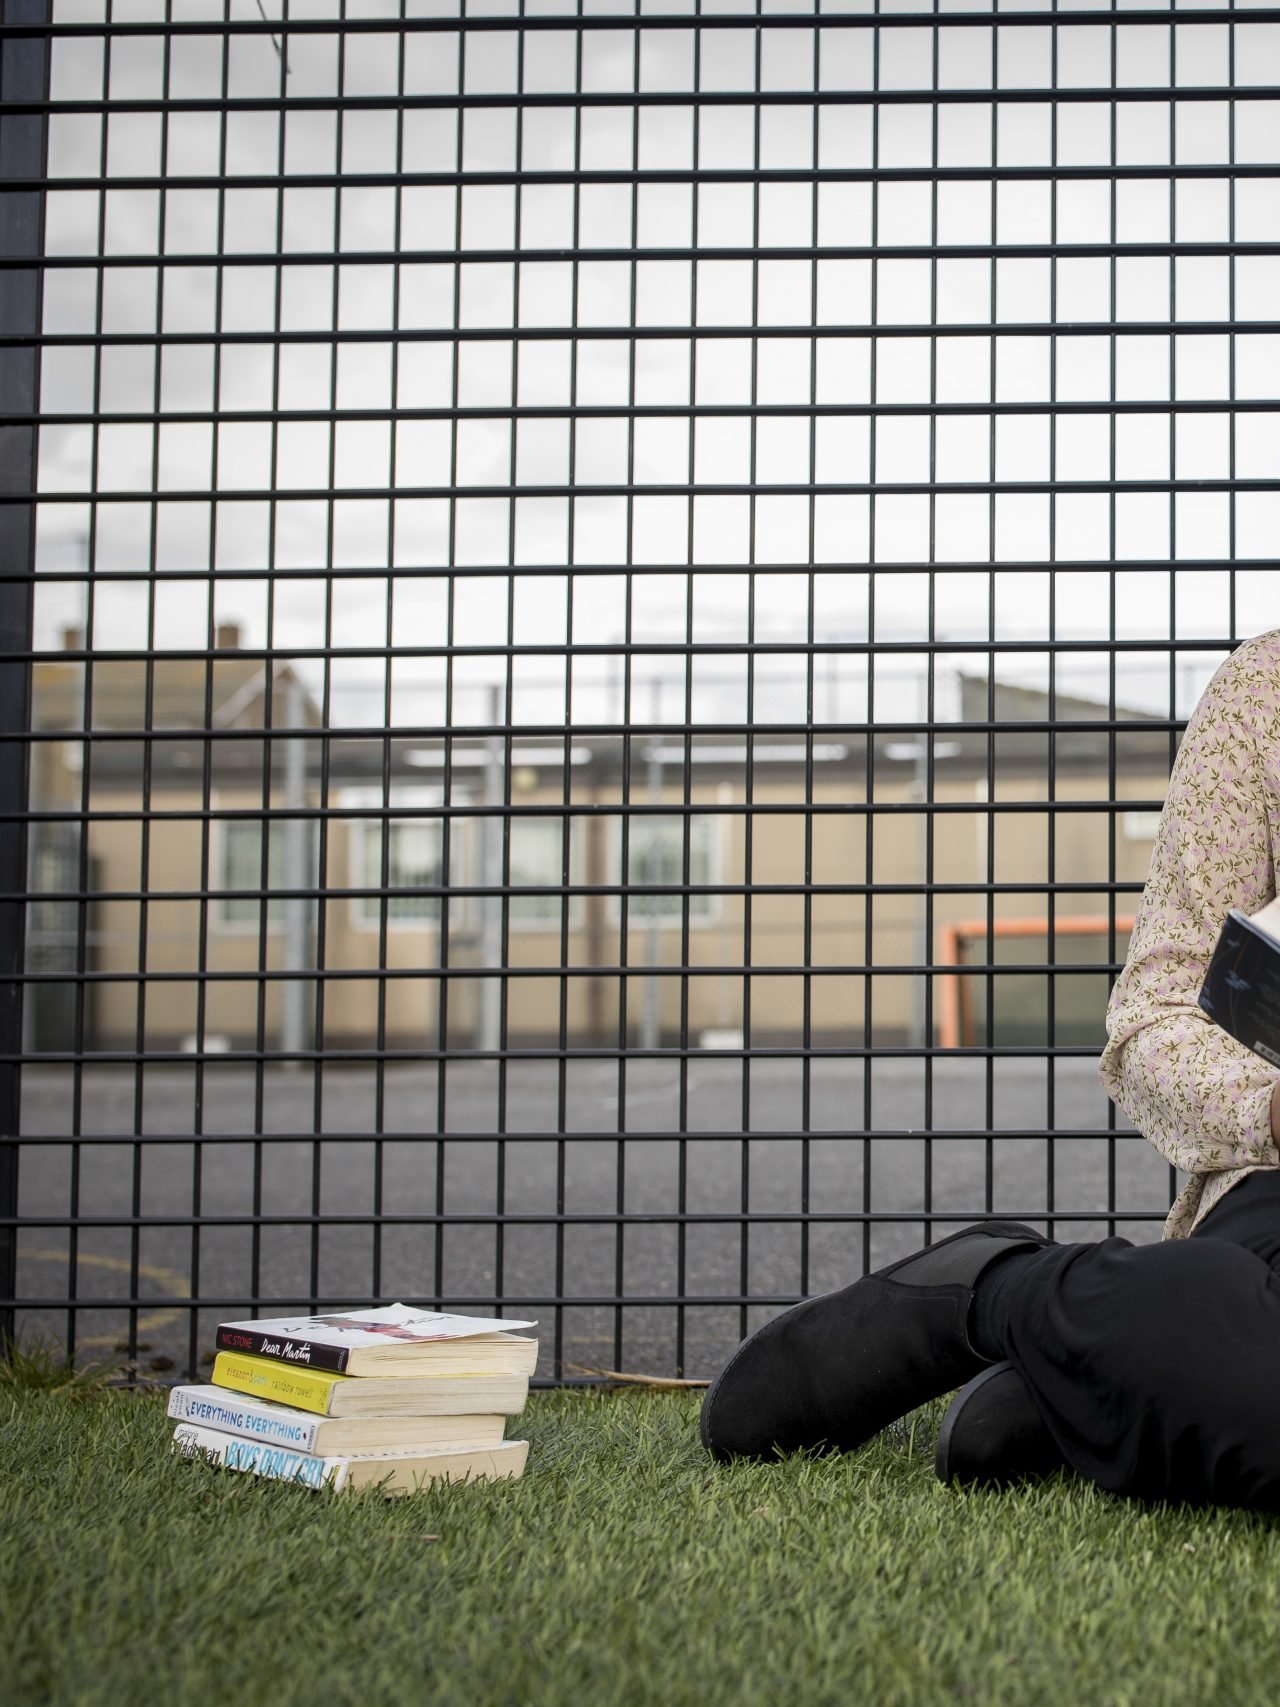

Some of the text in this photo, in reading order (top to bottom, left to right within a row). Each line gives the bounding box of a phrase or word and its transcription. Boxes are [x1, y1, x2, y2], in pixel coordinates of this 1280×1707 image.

[221, 1333, 253, 1349] NIC STONE
[260, 1337, 311, 1364] Dear Martin
[226, 1367, 249, 1381] eleanor
[271, 1378, 295, 1394] rainbow
[295, 1386, 314, 1399] rowell
[173, 1391, 181, 1417] nicola
[245, 1414, 302, 1440] EVERYTHING
[226, 1440, 323, 1489] BOYS DON'T CRY
